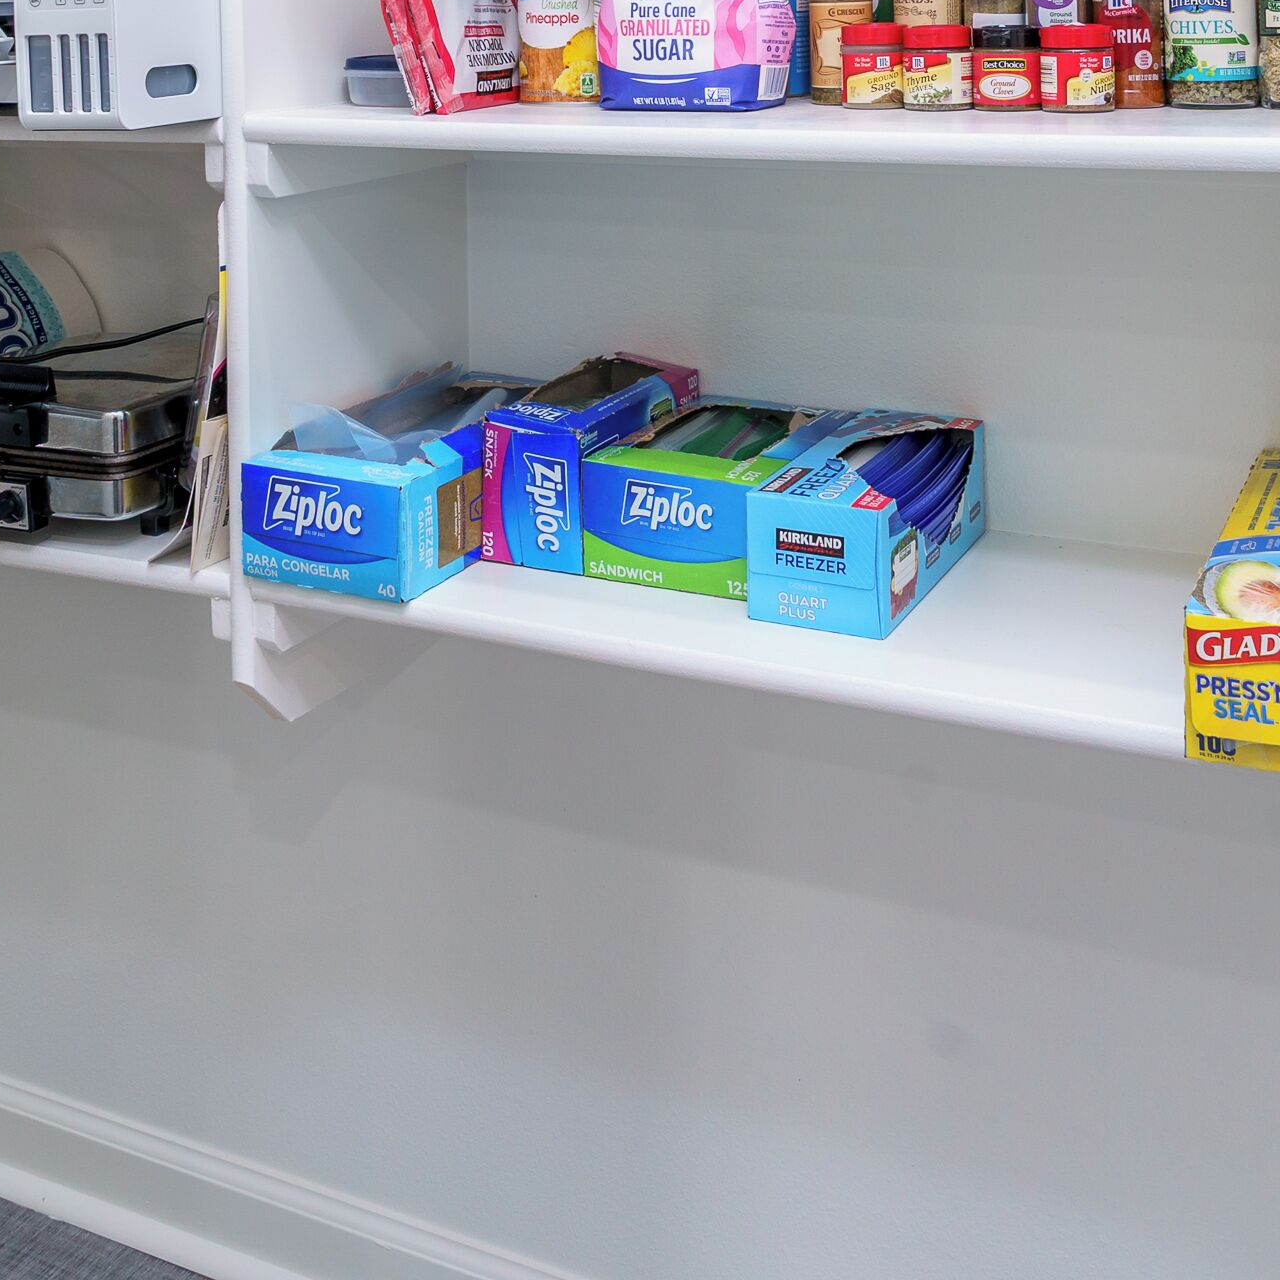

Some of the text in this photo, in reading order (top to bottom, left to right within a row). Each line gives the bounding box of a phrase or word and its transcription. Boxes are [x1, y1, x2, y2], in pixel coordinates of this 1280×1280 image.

[630, 2, 696, 18] Pure Cane
[837, 8, 865, 16] CRESCENT
[1104, 7, 1137, 17] McCormick
[526, 12, 580, 27] Pineapple
[1170, 20, 1233, 35] CHIVES
[620, 19, 710, 37] GRANULATED
[468, 38, 504, 52] POPCORN
[632, 38, 694, 61] SUGAR
[466, 51, 517, 67] MICROWAVE
[983, 60, 1025, 69] Best Choice
[867, 72, 899, 85] GROUND
[871, 79, 897, 93] Sage
[906, 73, 938, 87] Thyme
[990, 79, 1016, 87] Ground
[908, 84, 934, 94] LEAVES
[992, 86, 1014, 95] Cloves
[633, 97, 654, 105] NET WT
[687, 375, 699, 389] 120
[509, 402, 564, 422] Ziploc
[484, 428, 494, 480] SNACK
[741, 470, 762, 482] 125
[761, 469, 803, 492] KIRKLAND
[272, 483, 363, 537] Ziploc
[525, 462, 563, 552] Ziploc
[629, 485, 714, 531] Ziploc
[417, 511, 426, 562] GALLON
[423, 495, 435, 569] FREEZER
[778, 530, 843, 550] KIRKLAND
[482, 531, 494, 557] 120
[246, 552, 350, 581] PARA CONGELAR
[246, 565, 279, 578] GALÓN
[775, 552, 847, 575] FREEZER
[378, 583, 397, 598] 40
[777, 591, 828, 610] QUART
[777, 605, 816, 621] PLUS
[1213, 699, 1274, 725] SEAL
[1196, 732, 1237, 757] 100
